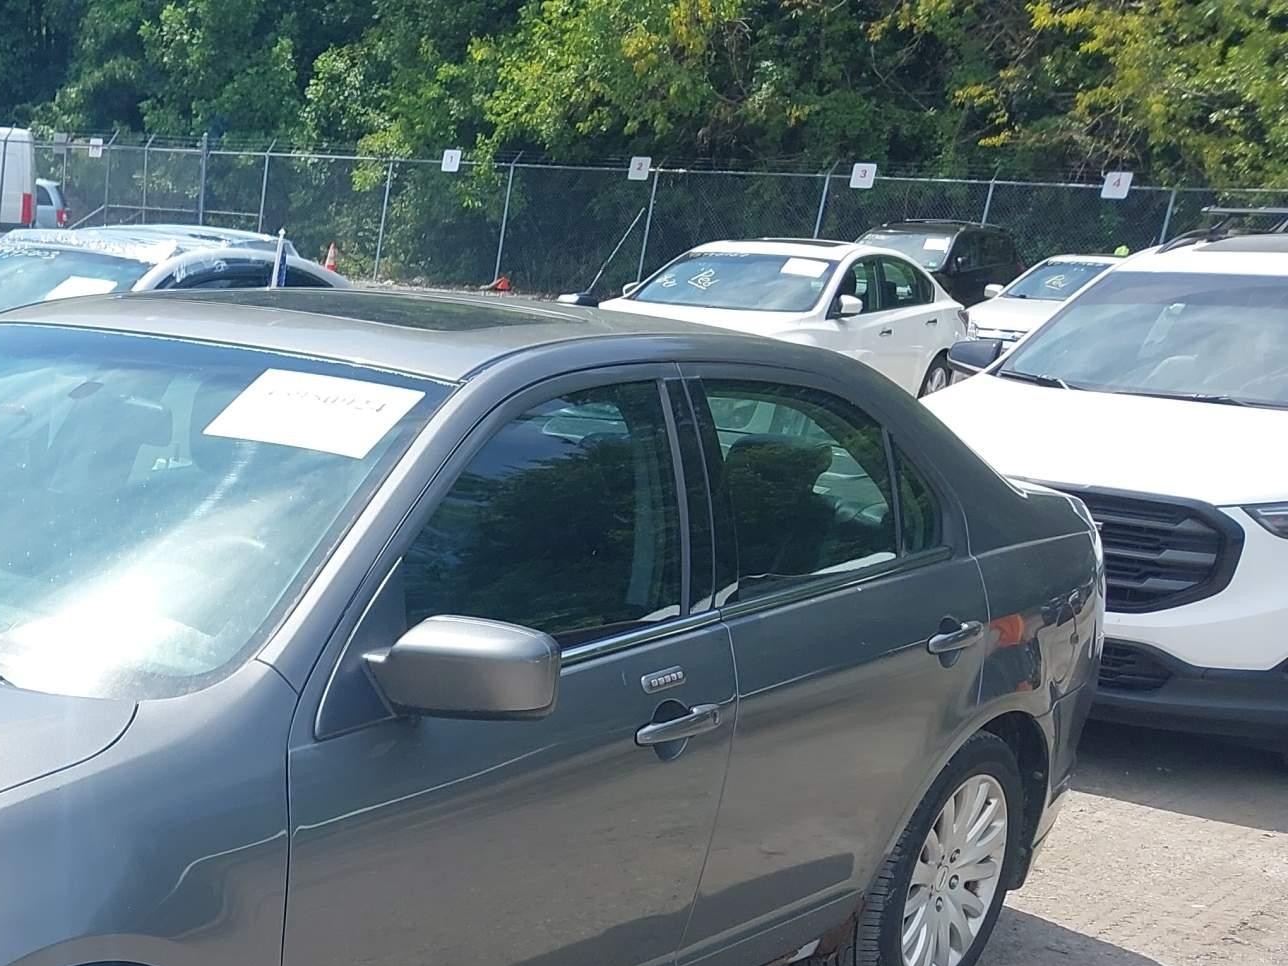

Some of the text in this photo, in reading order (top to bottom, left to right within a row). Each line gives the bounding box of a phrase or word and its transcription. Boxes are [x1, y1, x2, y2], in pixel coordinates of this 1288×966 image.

[636, 162, 644, 171] 2
[859, 168, 867, 178] 3
[1112, 177, 1121, 188] 4
